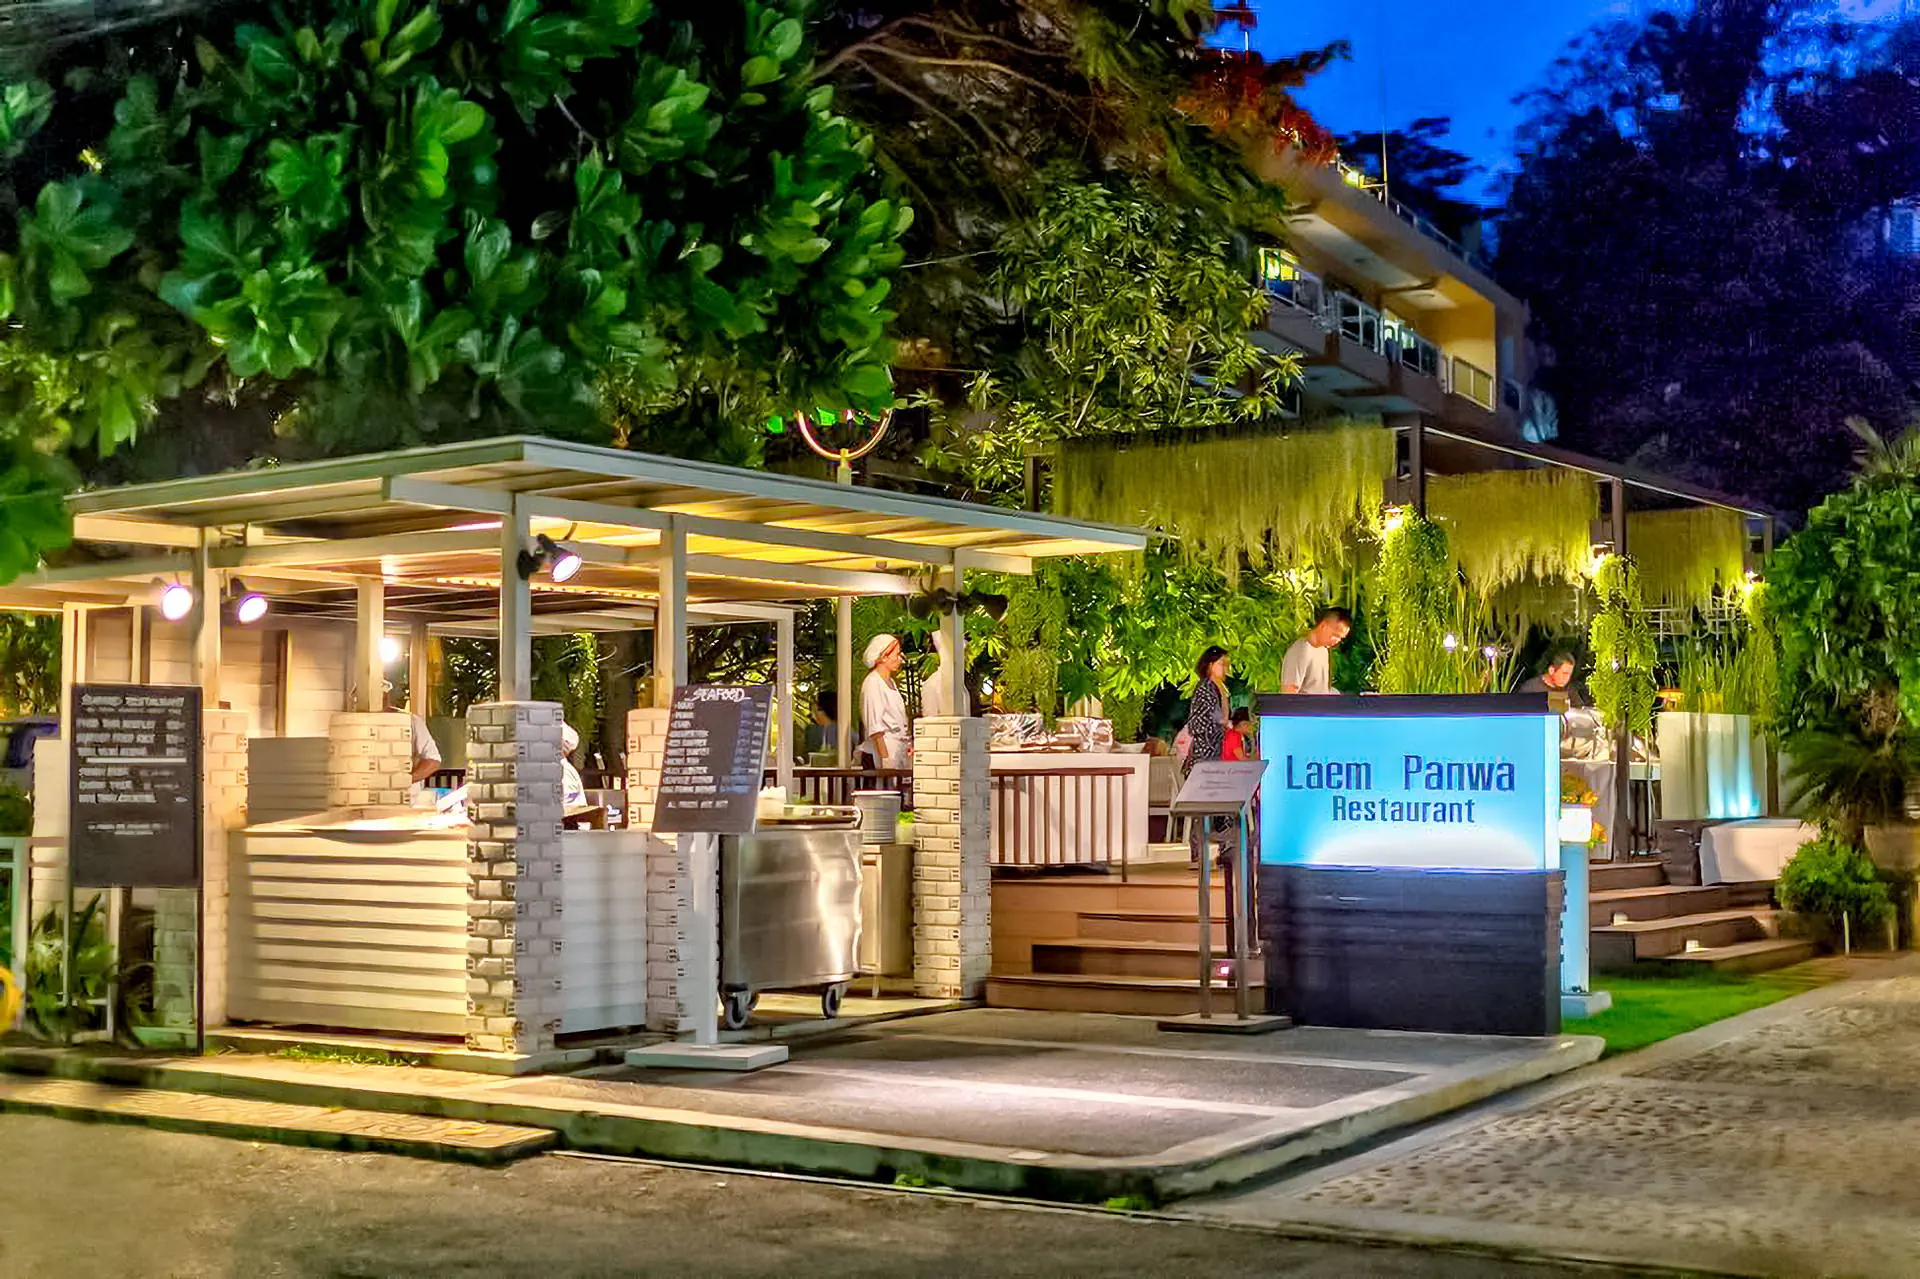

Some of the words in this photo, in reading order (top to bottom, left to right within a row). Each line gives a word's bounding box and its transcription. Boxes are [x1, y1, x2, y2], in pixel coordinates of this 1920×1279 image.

[684, 687, 751, 702] SEAFOOD
[1286, 754, 1372, 790] Laem
[1403, 754, 1515, 791] Panwa
[1332, 795, 1475, 823] Restaurant
